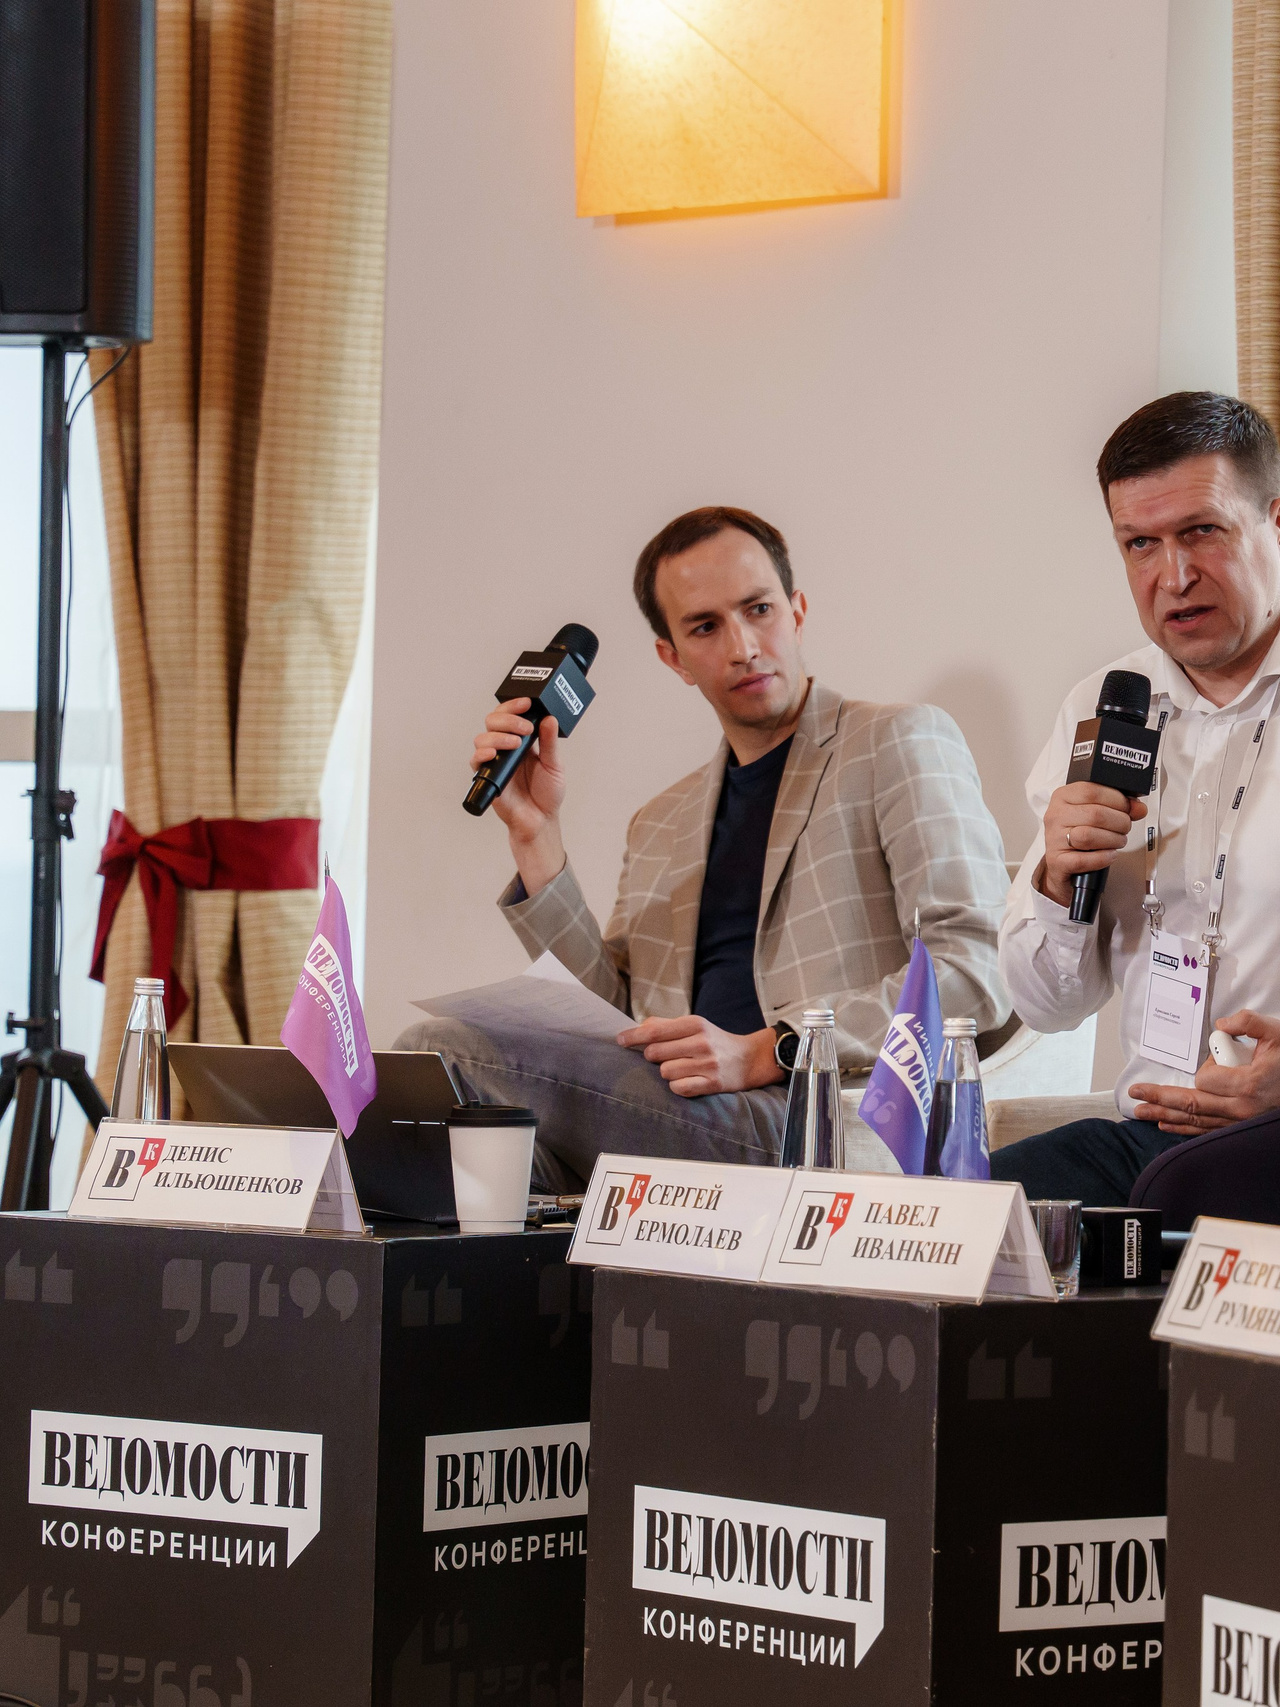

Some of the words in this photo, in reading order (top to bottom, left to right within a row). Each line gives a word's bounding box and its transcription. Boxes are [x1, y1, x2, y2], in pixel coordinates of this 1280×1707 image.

[1104, 744, 1149, 763] ВЕДОМОСТИ
[883, 1026, 932, 1124] ОМОСТИ
[102, 1148, 136, 1188] В
[161, 1145, 233, 1164] ДЕНИС
[153, 1172, 304, 1196] ИЛЬЮШЕНКОВ
[646, 1183, 724, 1211] СЕРГЕЙ
[597, 1185, 626, 1231] В
[793, 1205, 825, 1251] В
[863, 1201, 941, 1228] ПАВЕЛ
[634, 1219, 743, 1251] ЕРМОЛАЕВ
[852, 1236, 964, 1265] ИВАНКИН
[1126, 1221, 1135, 1276] ВЕДОМОСТИ
[42, 1430, 310, 1510] ВЕДОМОСТИ
[435, 1441, 590, 1516] ВЕДОМО
[42, 1520, 276, 1568] КОНФЕРЕНЦИИ
[643, 1508, 874, 1603] ВЕДОМОСТИ
[643, 1606, 845, 1668] КОНФЕРЕНЦИИ
[1015, 1639, 1163, 1677] КОНФЕР
